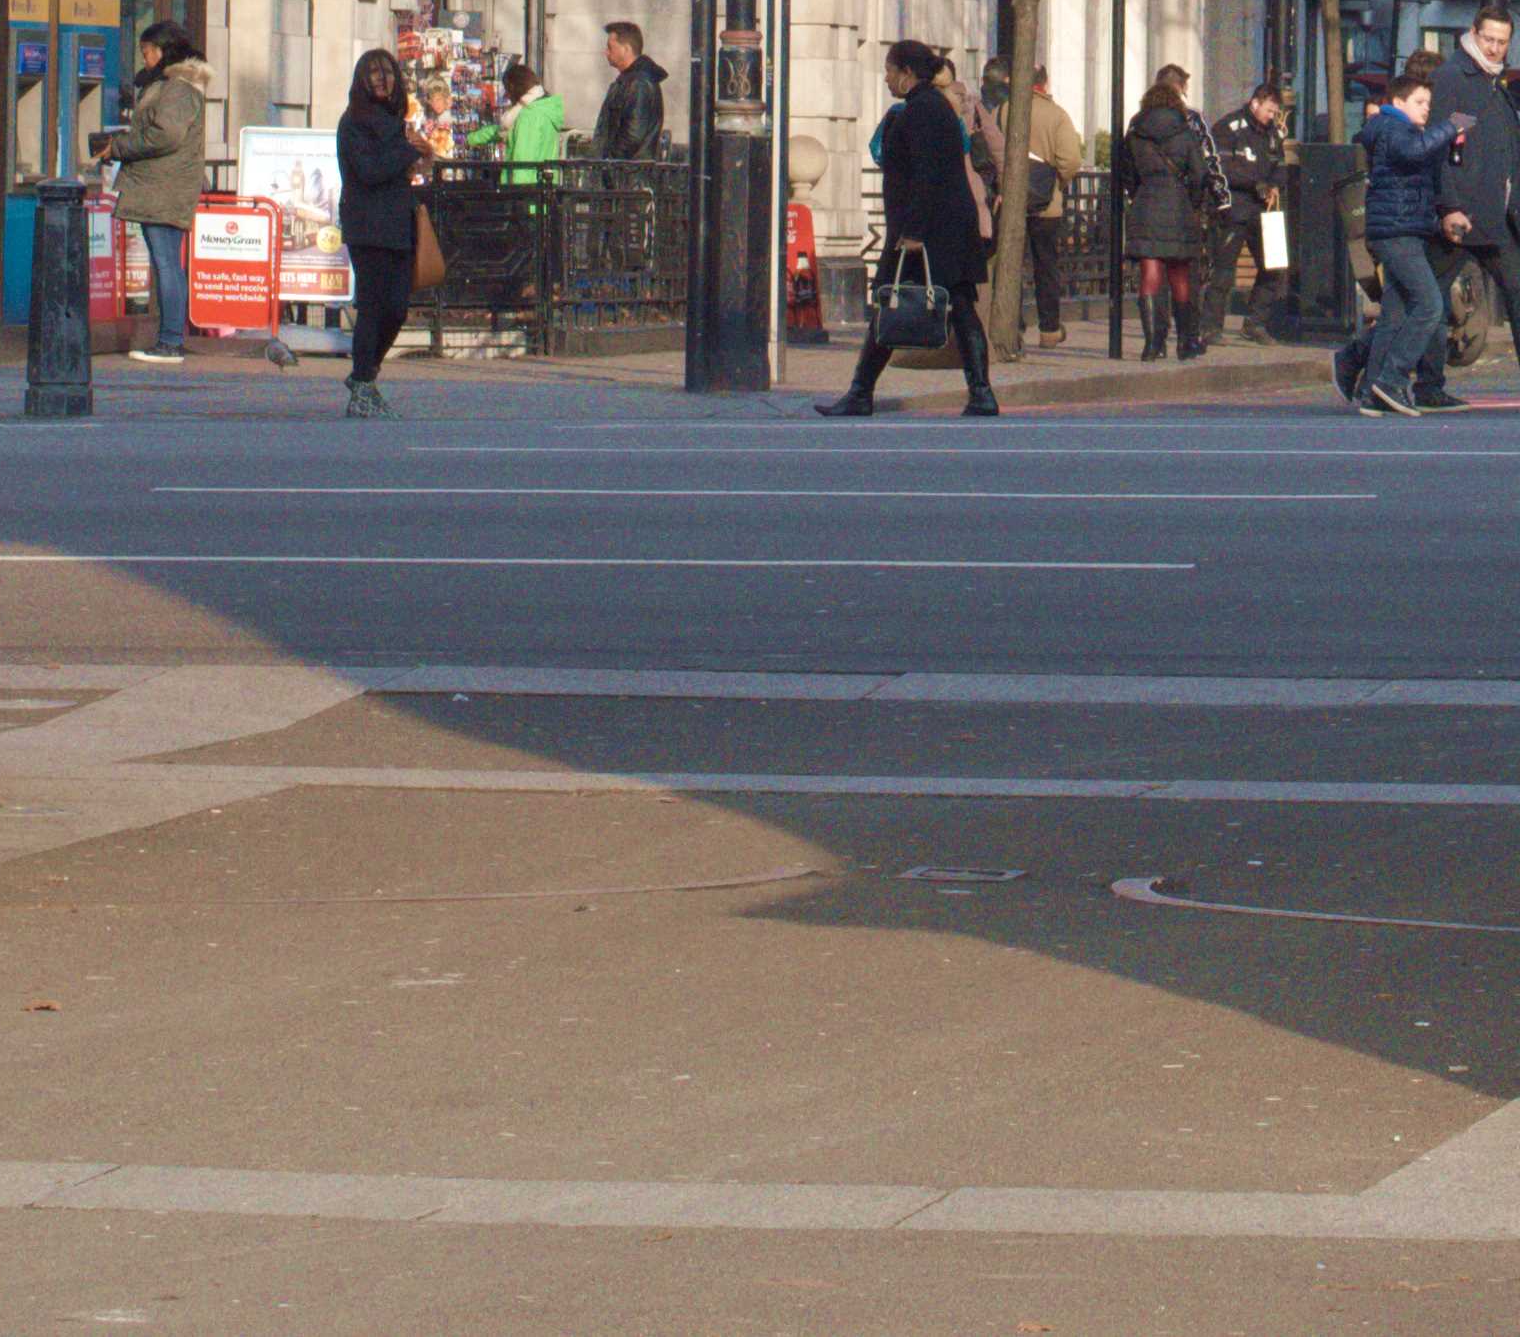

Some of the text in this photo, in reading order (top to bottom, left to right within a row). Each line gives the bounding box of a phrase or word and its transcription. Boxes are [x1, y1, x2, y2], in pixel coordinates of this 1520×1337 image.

[200, 233, 262, 248] MoneyGram
[196, 271, 212, 281] The
[248, 274, 266, 285] way
